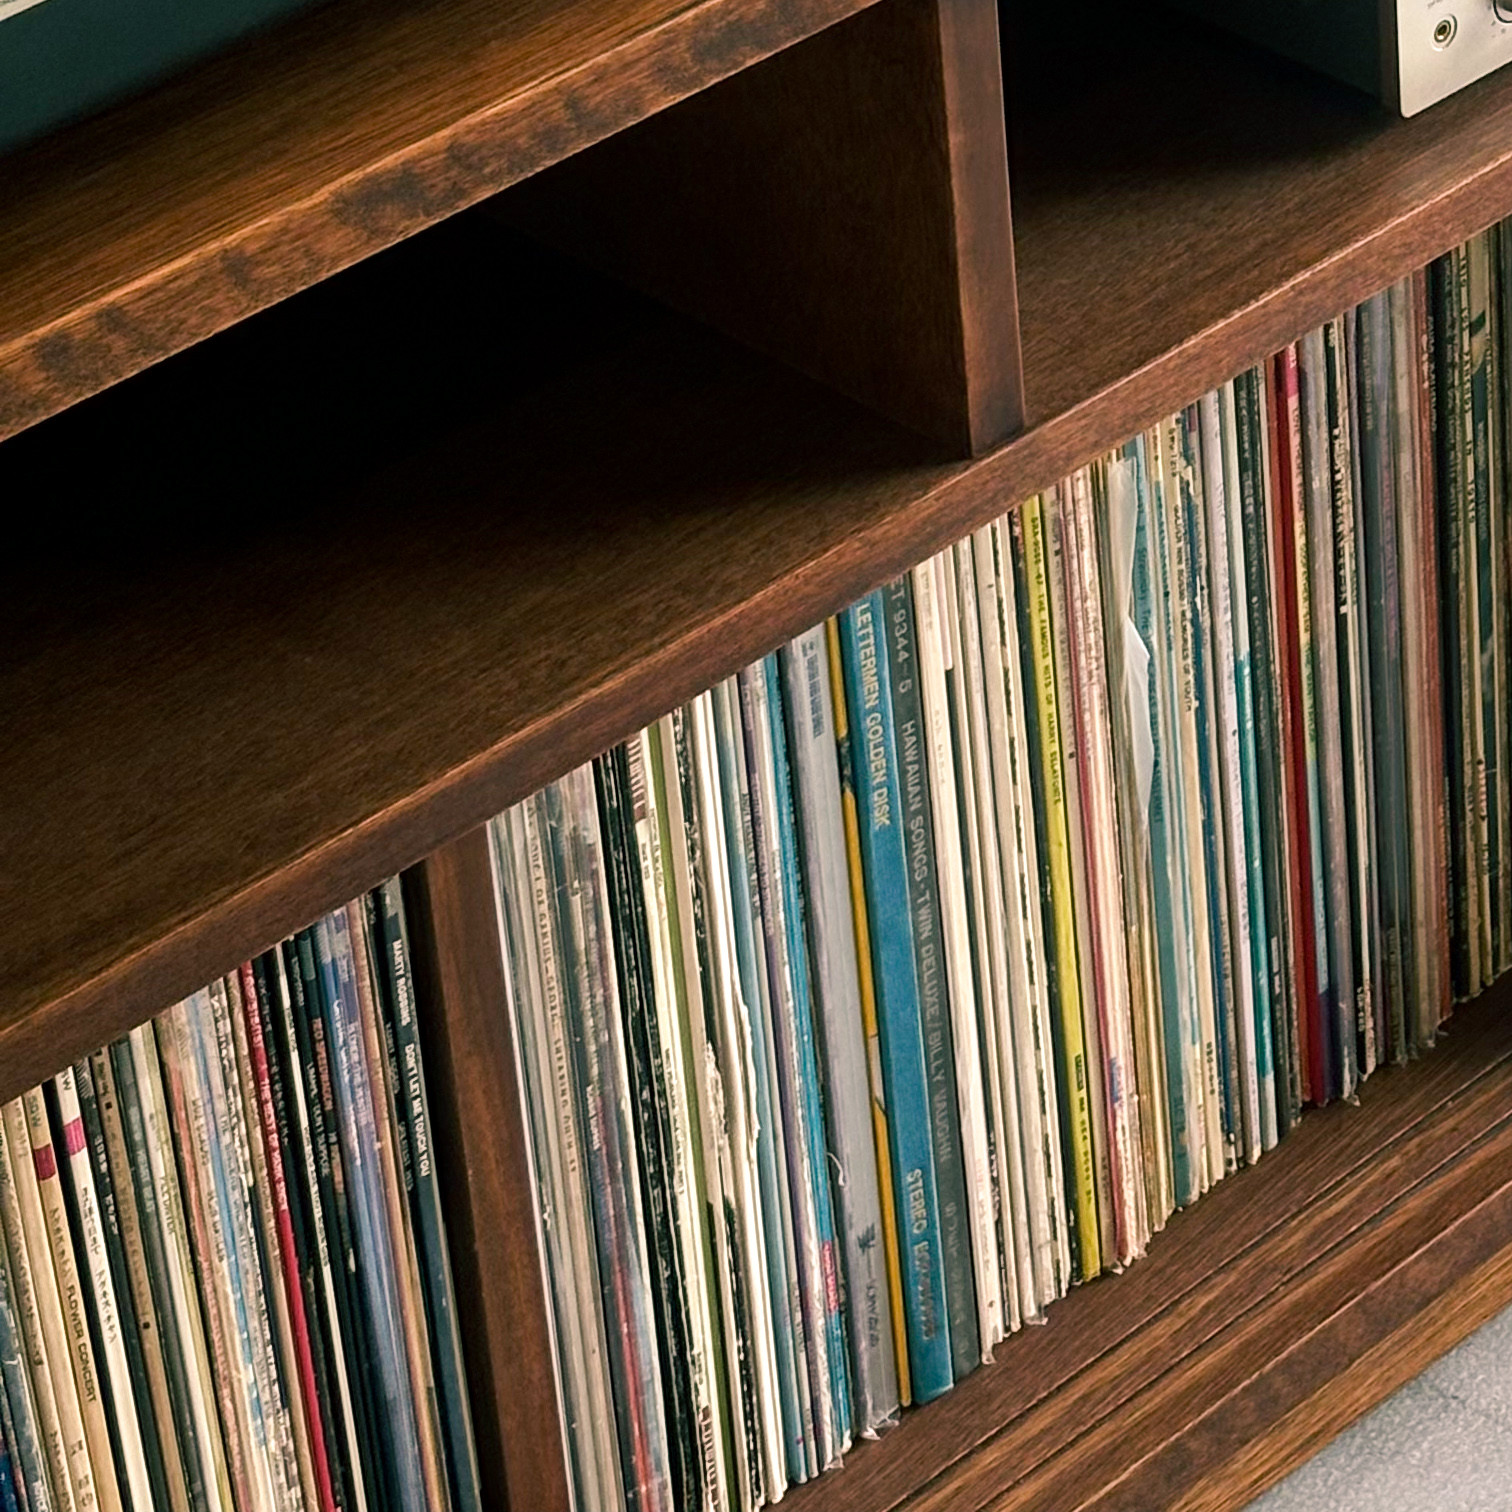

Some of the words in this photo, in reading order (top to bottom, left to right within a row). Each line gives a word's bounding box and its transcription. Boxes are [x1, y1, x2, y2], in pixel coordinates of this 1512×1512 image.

[1465, 478, 1475, 524] TOKYO
[1035, 592, 1046, 613] THE
[1037, 618, 1050, 659] FAMOUS
[1177, 608, 1191, 661] MEMORIES
[853, 602, 880, 709] LETTERMEN
[1181, 662, 1192, 676] OF
[1041, 663, 1052, 689] HITS
[1044, 692, 1054, 707] OF
[1182, 678, 1194, 713] YOUTH
[1045, 711, 1057, 745] HARRY
[864, 711, 888, 785] GOLDEN
[1048, 749, 1062, 806] BELAFONTE
[871, 786, 892, 830] DISK
[390, 938, 406, 976] MARTY
[901, 719, 923, 811] HAWAIIAN
[932, 1088, 952, 1162] VAUGHN
[394, 976, 412, 1027] ROBBINS
[314, 1039, 335, 1112] SPEEDWAGON
[403, 1042, 418, 1077] DON'T
[257, 1077, 271, 1100] THE
[407, 1076, 420, 1098] LET
[261, 1101, 276, 1132] BEST
[410, 1097, 423, 1117] ME
[412, 1116, 428, 1153] TOUCH
[417, 1152, 430, 1178] YOU
[905, 1167, 928, 1235] STEREO
[64, 1284, 85, 1339] FLOWER
[76, 1342, 97, 1403] CONCERT
